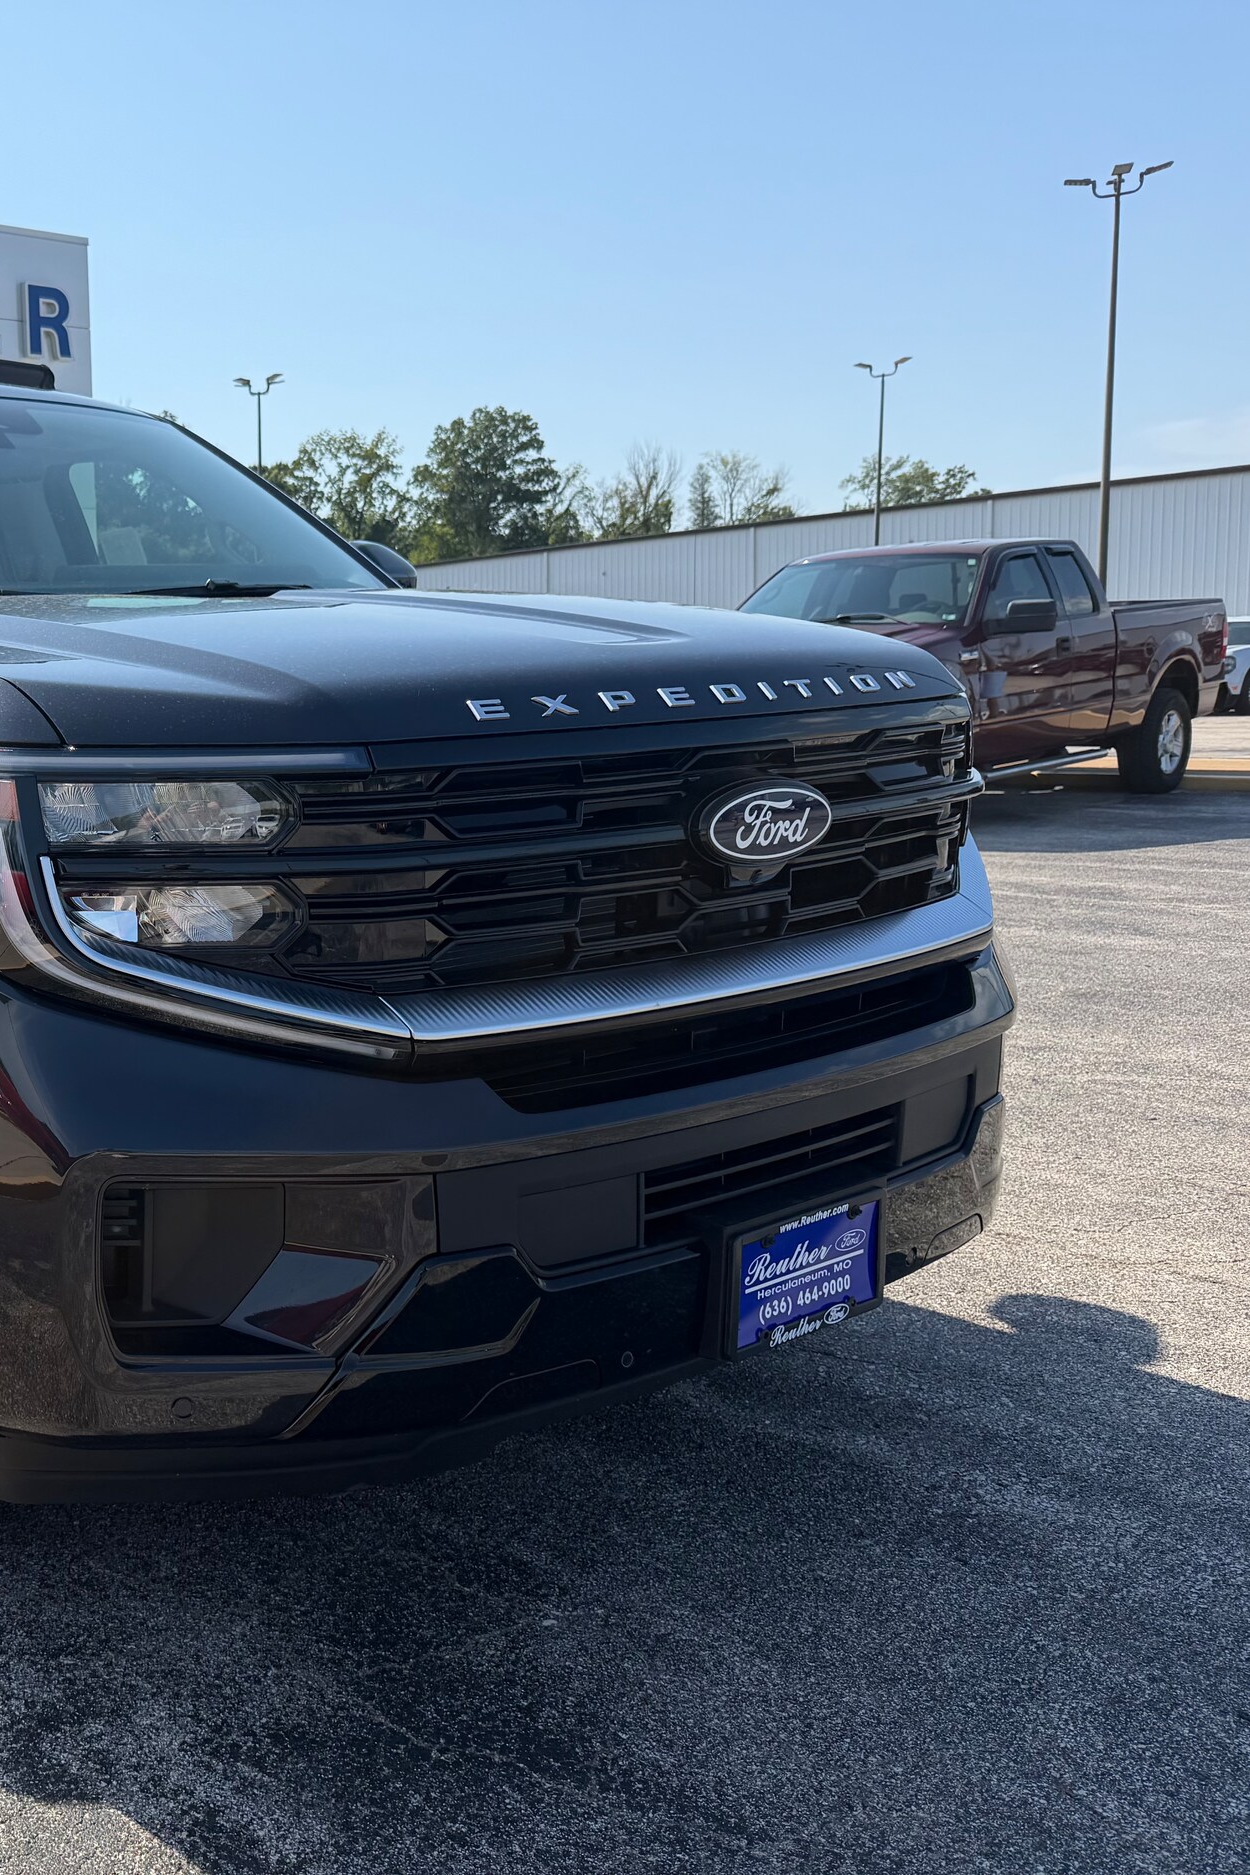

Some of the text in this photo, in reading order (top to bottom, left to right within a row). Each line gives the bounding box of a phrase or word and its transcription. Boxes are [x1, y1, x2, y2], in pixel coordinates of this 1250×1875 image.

[466, 671, 918, 721] EXPEDITION
[736, 799, 811, 849] Ford
[779, 1203, 849, 1233] www.Reuther.com
[744, 1240, 833, 1286] Reuther
[757, 1260, 852, 1300] Herculaneum, MO
[759, 1275, 851, 1325] (636) 464-9000
[769, 1316, 823, 1347] Reuther
